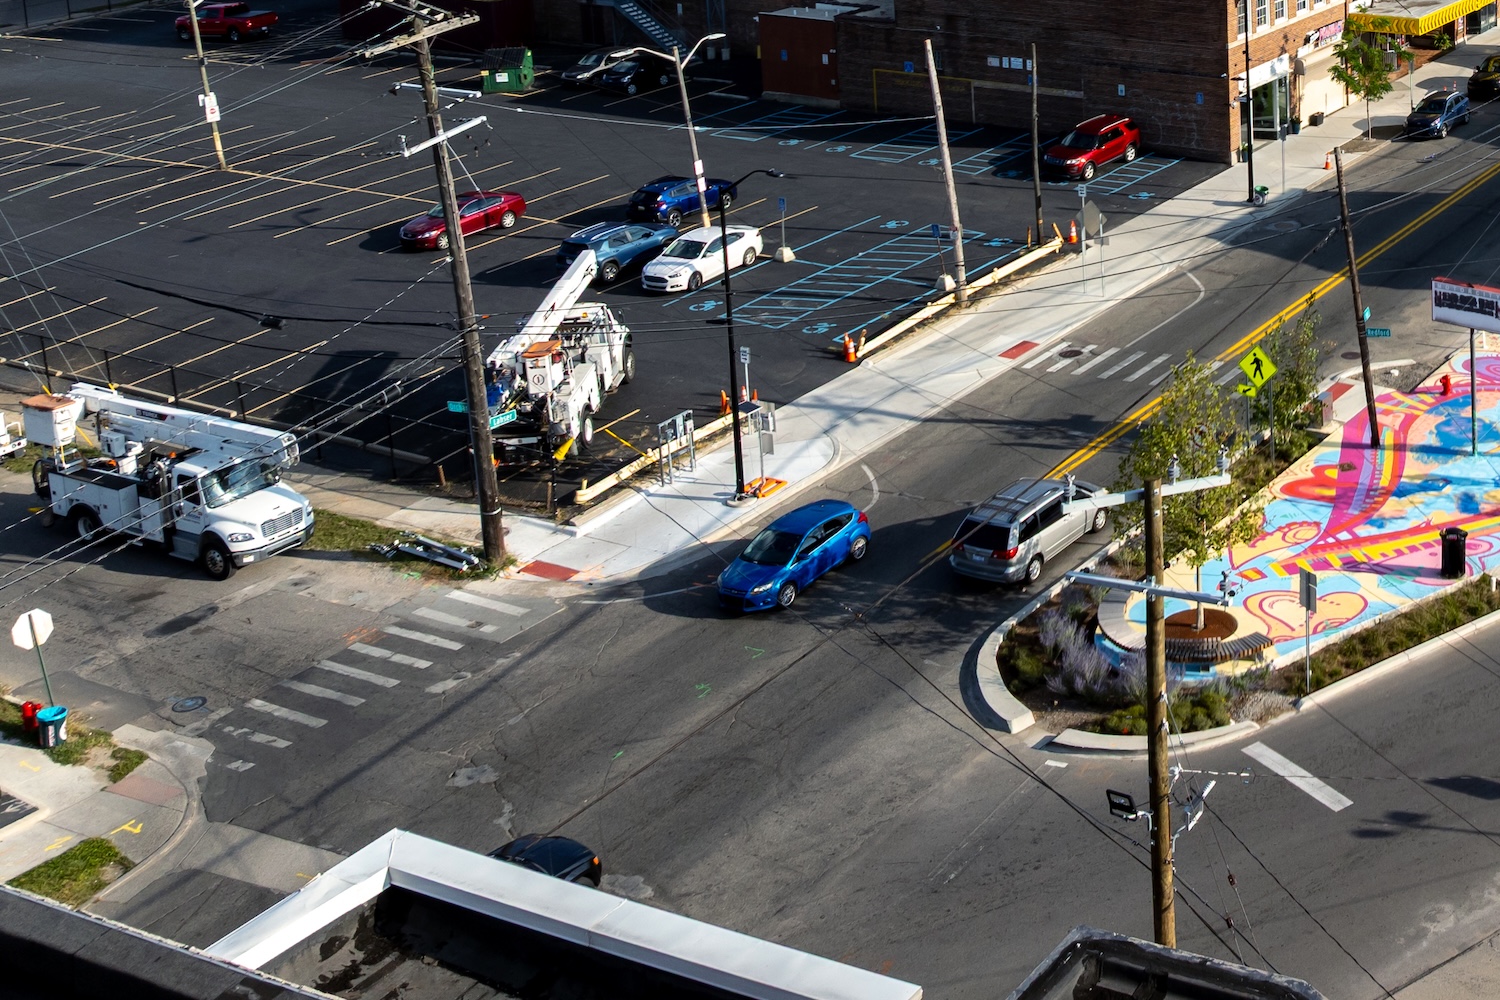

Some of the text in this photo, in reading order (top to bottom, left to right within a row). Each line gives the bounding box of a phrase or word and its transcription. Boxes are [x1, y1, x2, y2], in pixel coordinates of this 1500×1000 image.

[1367, 328, 1390, 337] Redford
[449, 403, 469, 411] Orchar
[493, 413, 513, 426] Lahser
